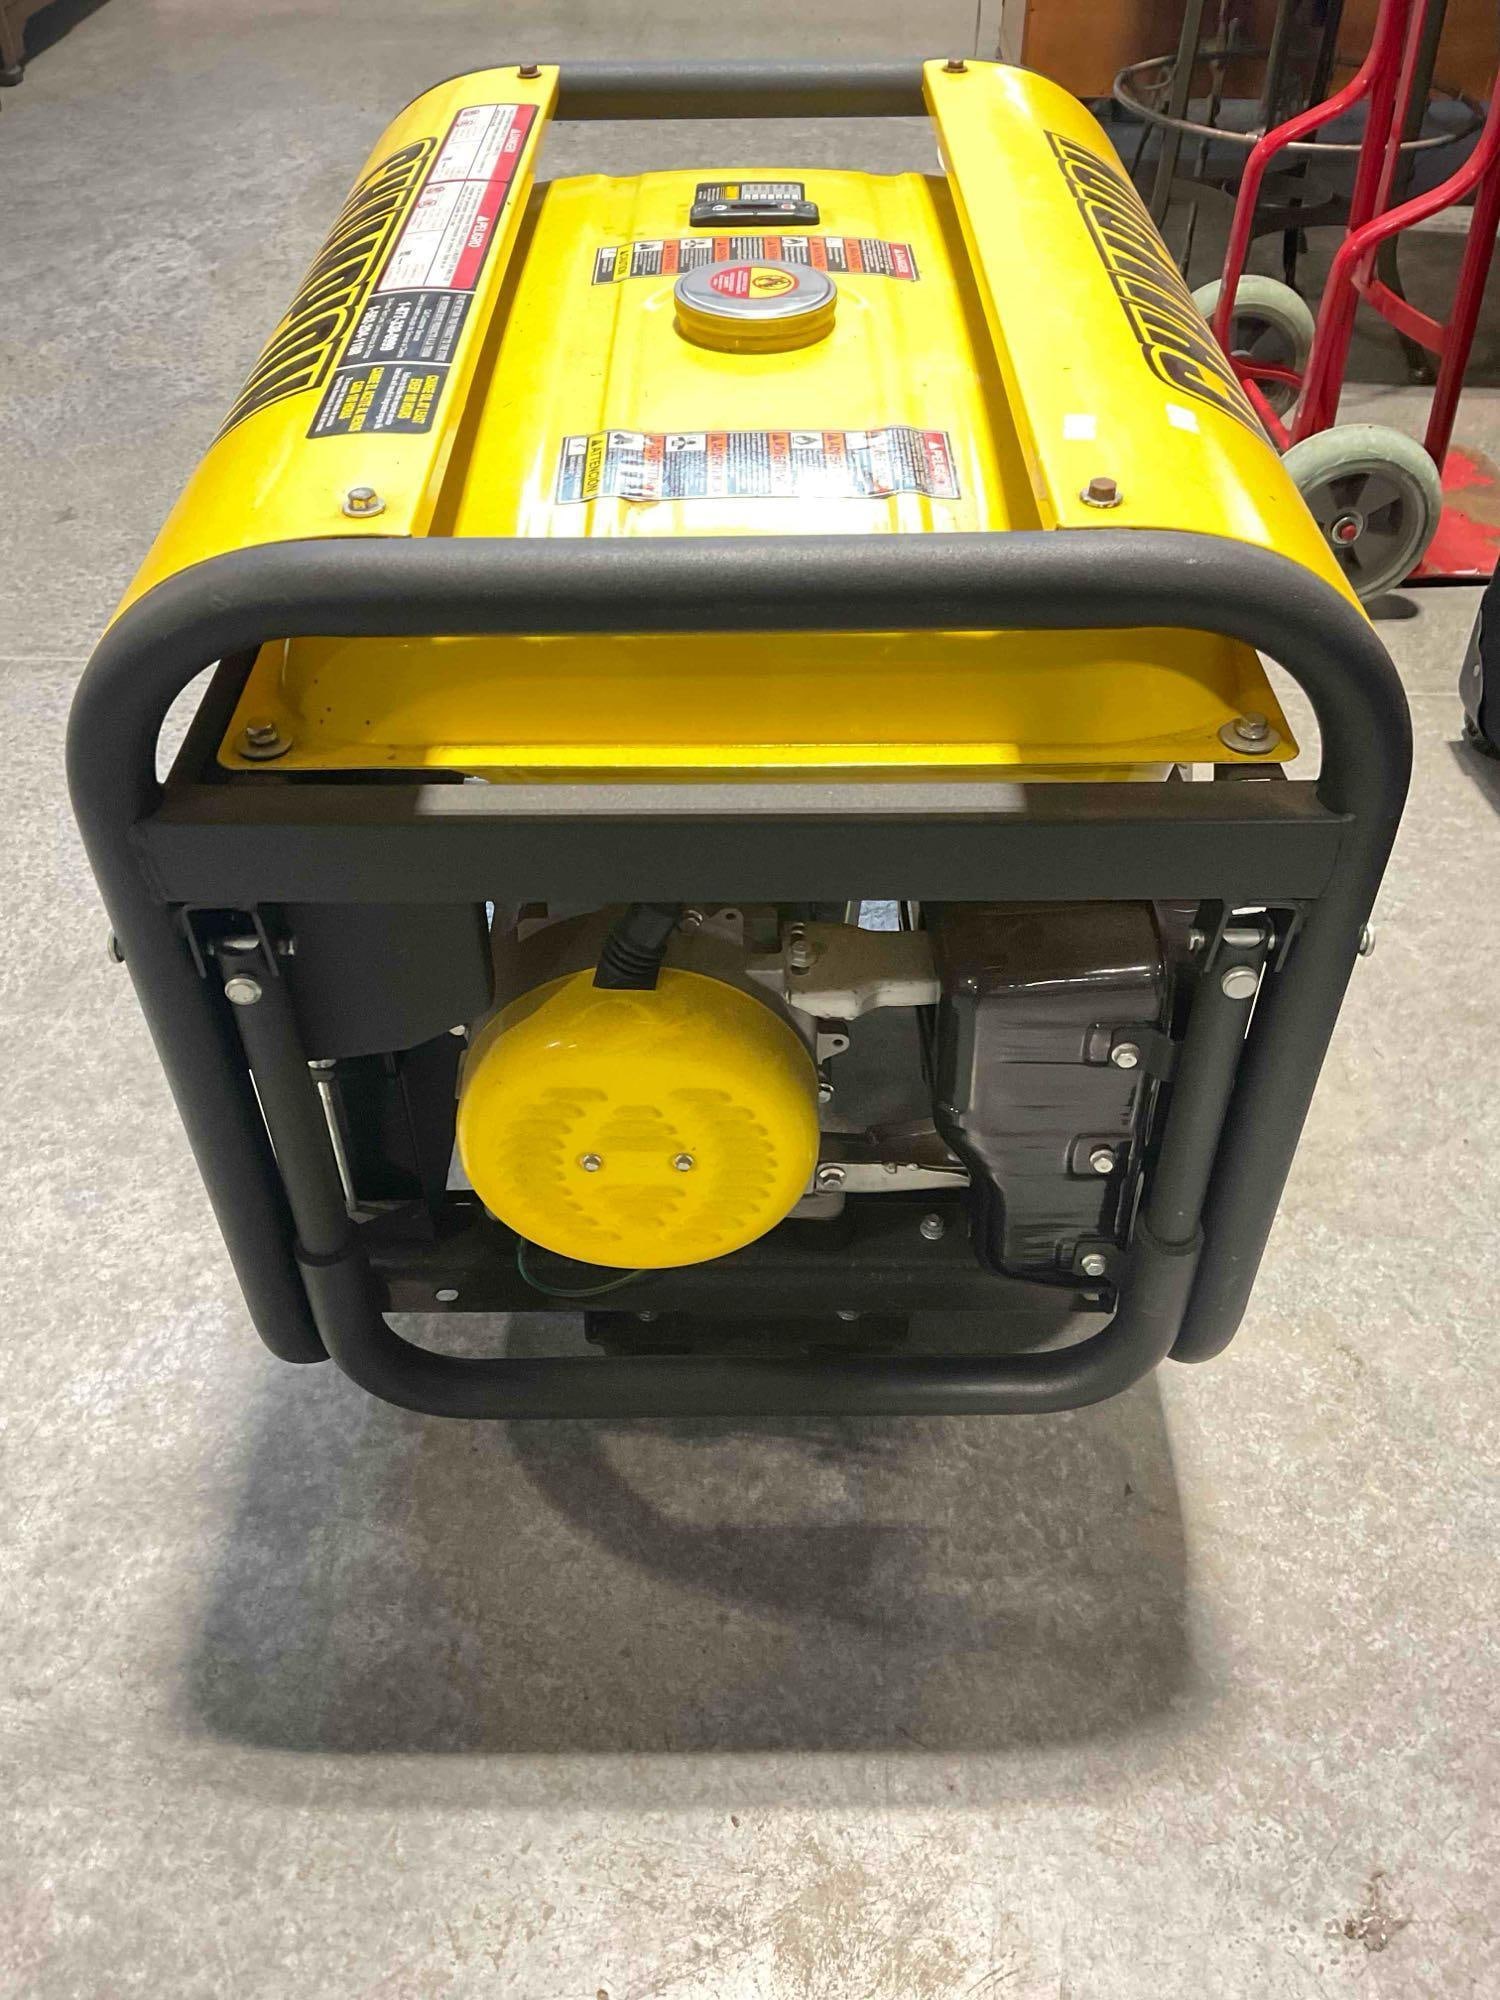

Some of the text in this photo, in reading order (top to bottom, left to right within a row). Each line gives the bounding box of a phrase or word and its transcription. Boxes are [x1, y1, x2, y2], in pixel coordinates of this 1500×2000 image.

[468, 219, 488, 248] PELIGRO
[208, 136, 437, 444] CHAMPION
[1044, 130, 1267, 443] CHAMPION
[422, 374, 439, 393] CHANGE
[411, 408, 429, 424] LEAST
